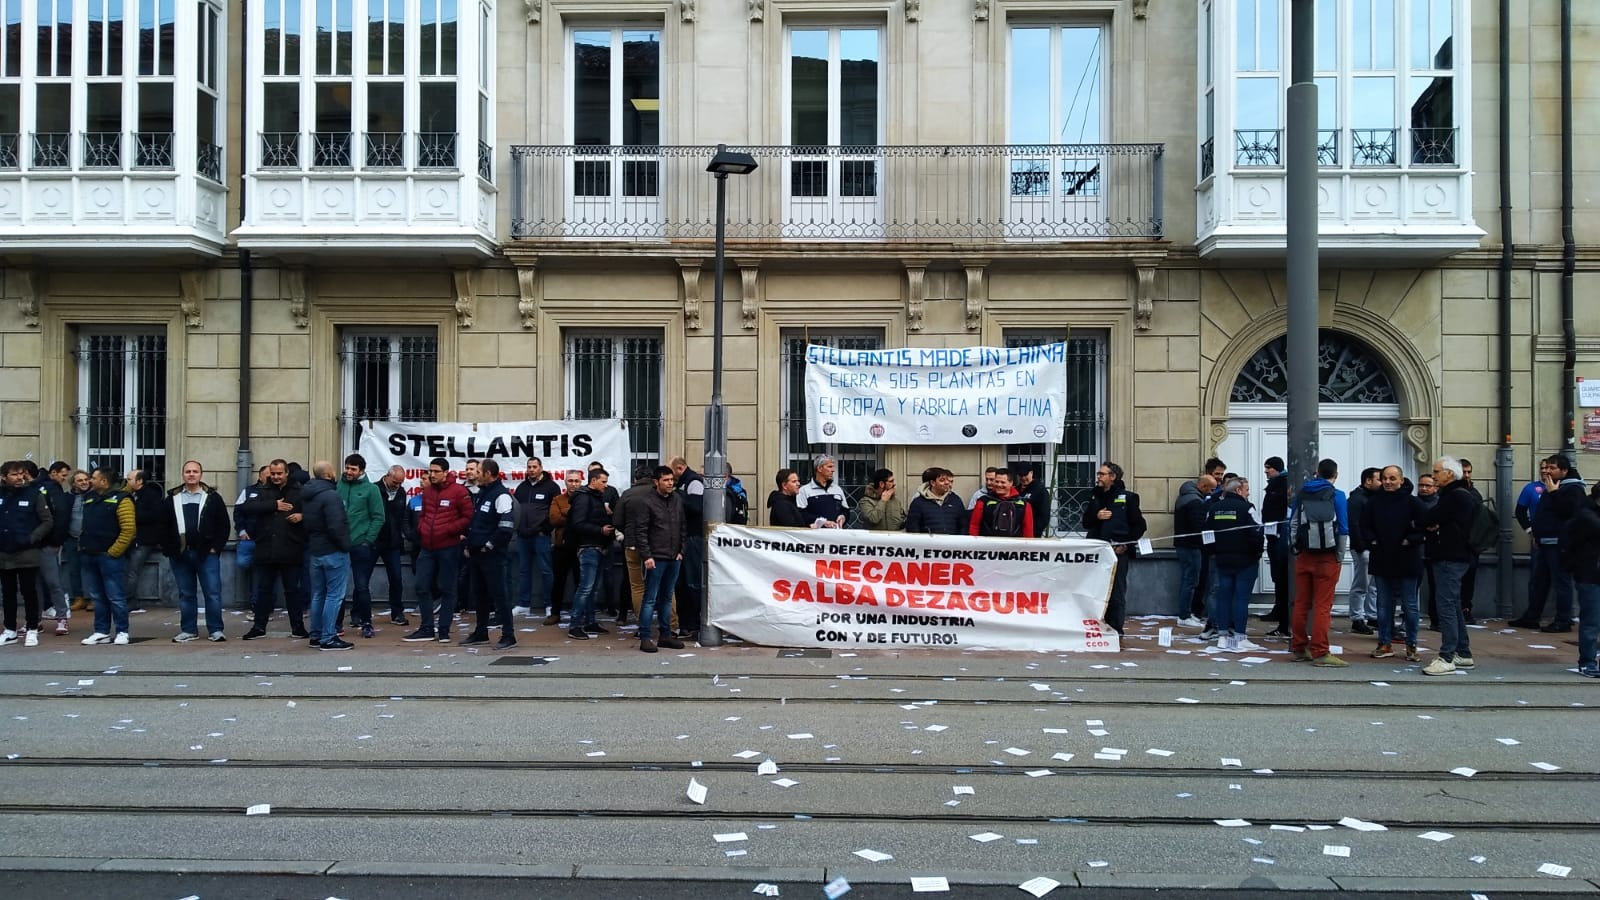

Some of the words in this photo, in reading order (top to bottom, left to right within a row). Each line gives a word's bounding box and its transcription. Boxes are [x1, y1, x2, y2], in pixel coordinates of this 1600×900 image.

[808, 345, 912, 368] STELLANTIS
[919, 348, 973, 368] MADE
[979, 347, 1001, 367] IN
[1006, 342, 1066, 366] CHINA
[829, 372, 878, 388] CIERRA
[889, 372, 919, 389] SUS
[928, 370, 1006, 389] PLANTAS
[1016, 369, 1036, 387] EN
[819, 396, 886, 416] EUROPA
[897, 397, 907, 415] Y
[913, 396, 968, 416] FABRICA
[977, 396, 998, 416] EN
[1007, 396, 1052, 417] CHINA
[997, 427, 1013, 435] Jeep
[388, 433, 593, 459] STELLANTIS
[717, 536, 825, 554] INDUSTRIAREN
[829, 544, 920, 560] DEFENTSAN,
[923, 548, 1050, 562] ETORKIZUNAREN
[1053, 552, 1100, 564] ALDE!
[815, 558, 975, 587] MECANER
[772, 579, 879, 606] SALBA
[885, 587, 1050, 615] DEZAGUN!
[816, 612, 851, 625] ¡POR
[855, 613, 888, 625] UNA
[891, 614, 976, 628] INDUSTRIA
[815, 629, 848, 642] CON
[852, 631, 863, 643] Y
[867, 632, 887, 644] DE
[891, 632, 958, 645] FUTURO!
